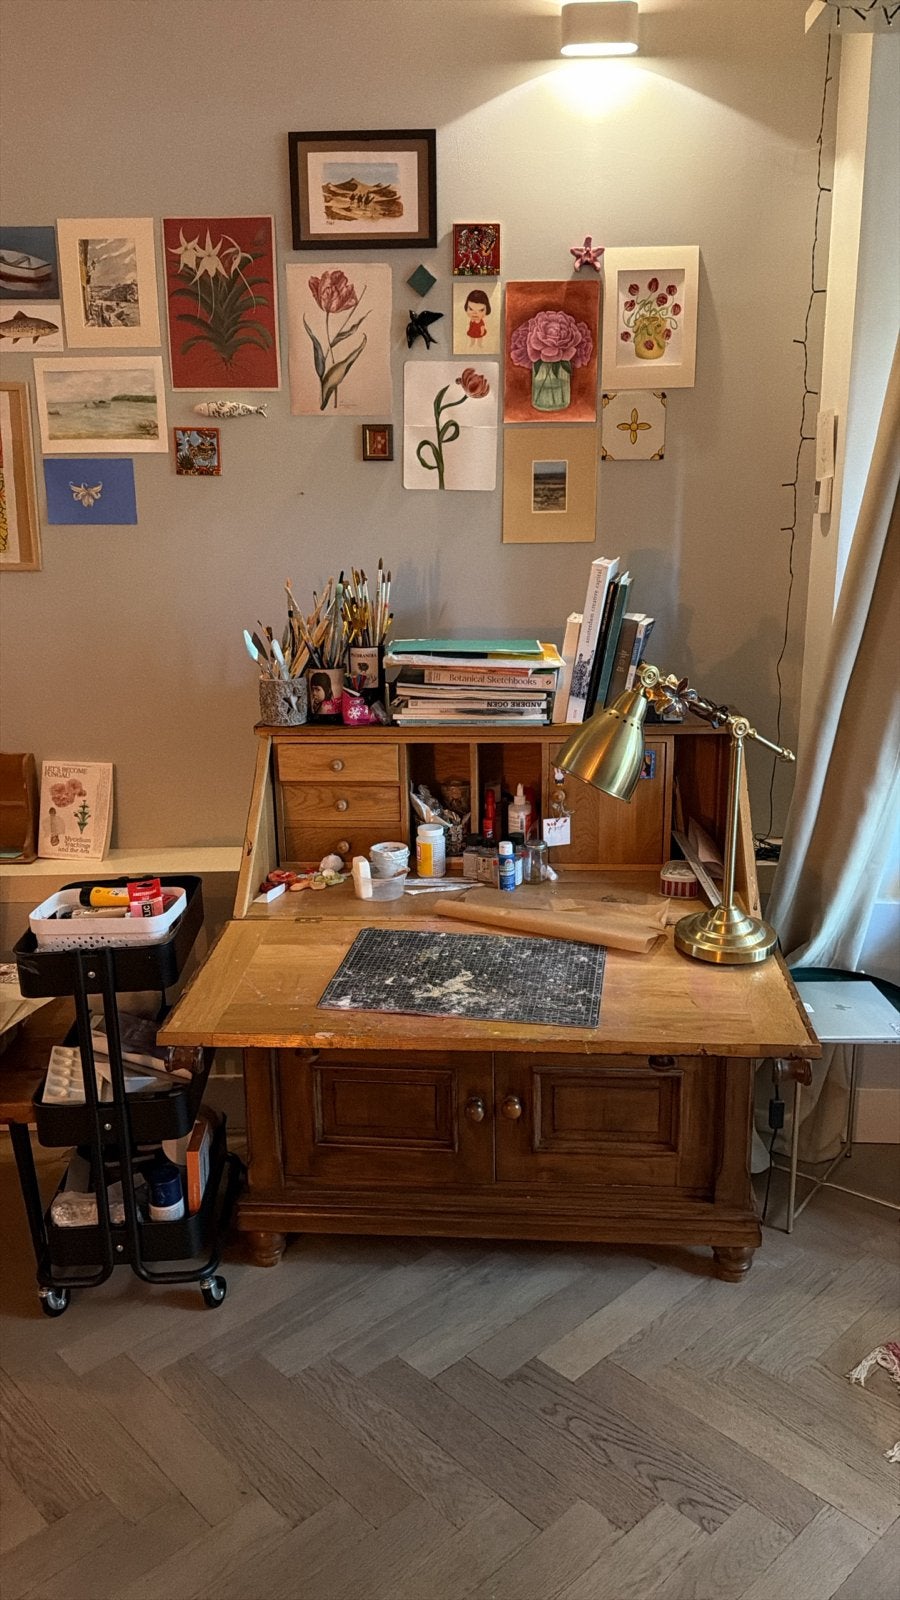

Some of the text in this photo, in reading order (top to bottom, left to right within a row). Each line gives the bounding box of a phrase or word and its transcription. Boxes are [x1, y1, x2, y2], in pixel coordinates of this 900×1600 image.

[591, 588, 599, 612] creative
[449, 674, 485, 684] Botanical
[487, 677, 537, 686] Sketchbooks
